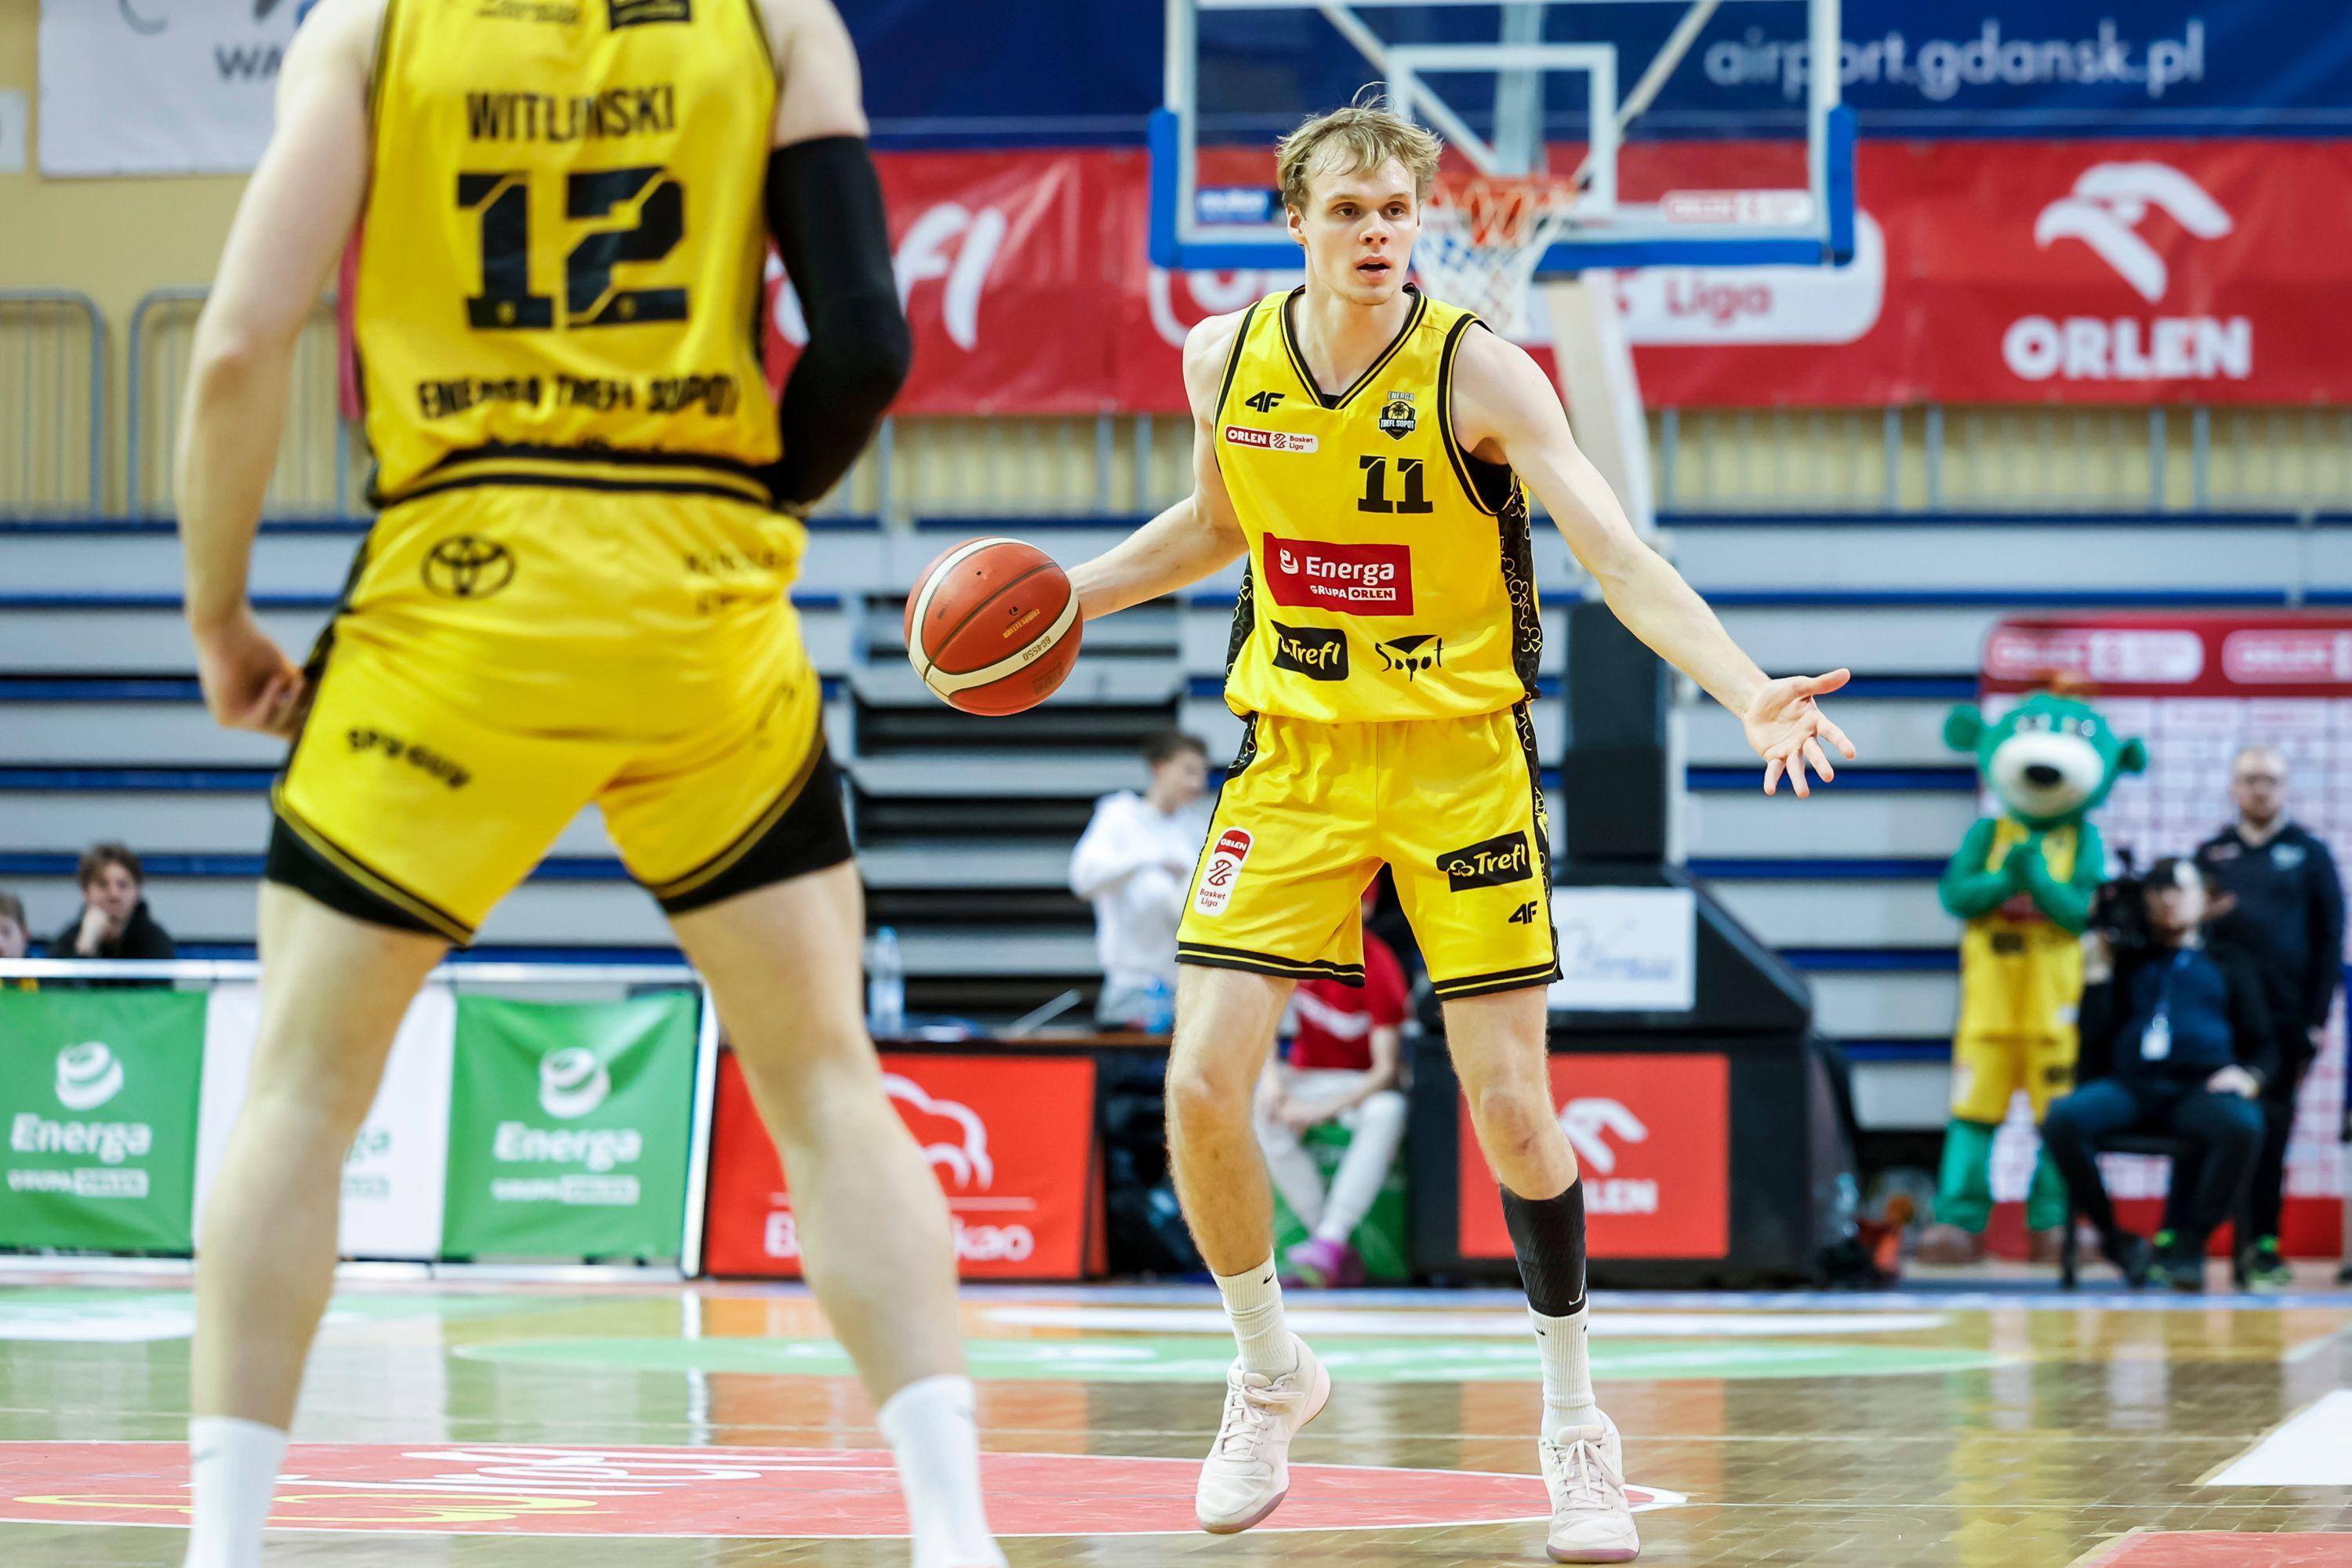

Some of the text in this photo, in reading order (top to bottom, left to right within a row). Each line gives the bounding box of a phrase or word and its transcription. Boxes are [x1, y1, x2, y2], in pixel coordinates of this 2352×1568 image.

[1704, 17, 2205, 100] airport.gdansk.pl
[456, 165, 688, 330] 12
[2002, 315, 2252, 380] ORLEN
[1244, 390, 1286, 413] 4F
[1388, 391, 1414, 402] ENERGA
[1228, 429, 1267, 445] ORLEN
[1380, 419, 1415, 430] TREFL SOPOT
[1289, 442, 1304, 451] Liga
[1290, 435, 1313, 444] Basket
[1357, 455, 1434, 514] 11
[1306, 556, 1395, 586] Energa
[1309, 585, 1393, 599] GRUPA ORLEN
[1288, 638, 1341, 670] Trefl
[1374, 637, 1444, 683] Sopot
[1220, 838, 1248, 851] ORLEN
[1473, 844, 1526, 876] Trefl
[1199, 887, 1226, 900] Basket
[1200, 897, 1218, 908] Liga
[1508, 900, 1538, 925] 4F
[11, 1112, 153, 1165] Energa
[494, 1120, 643, 1172] Energa
[949, 1215, 1035, 1261] kao
